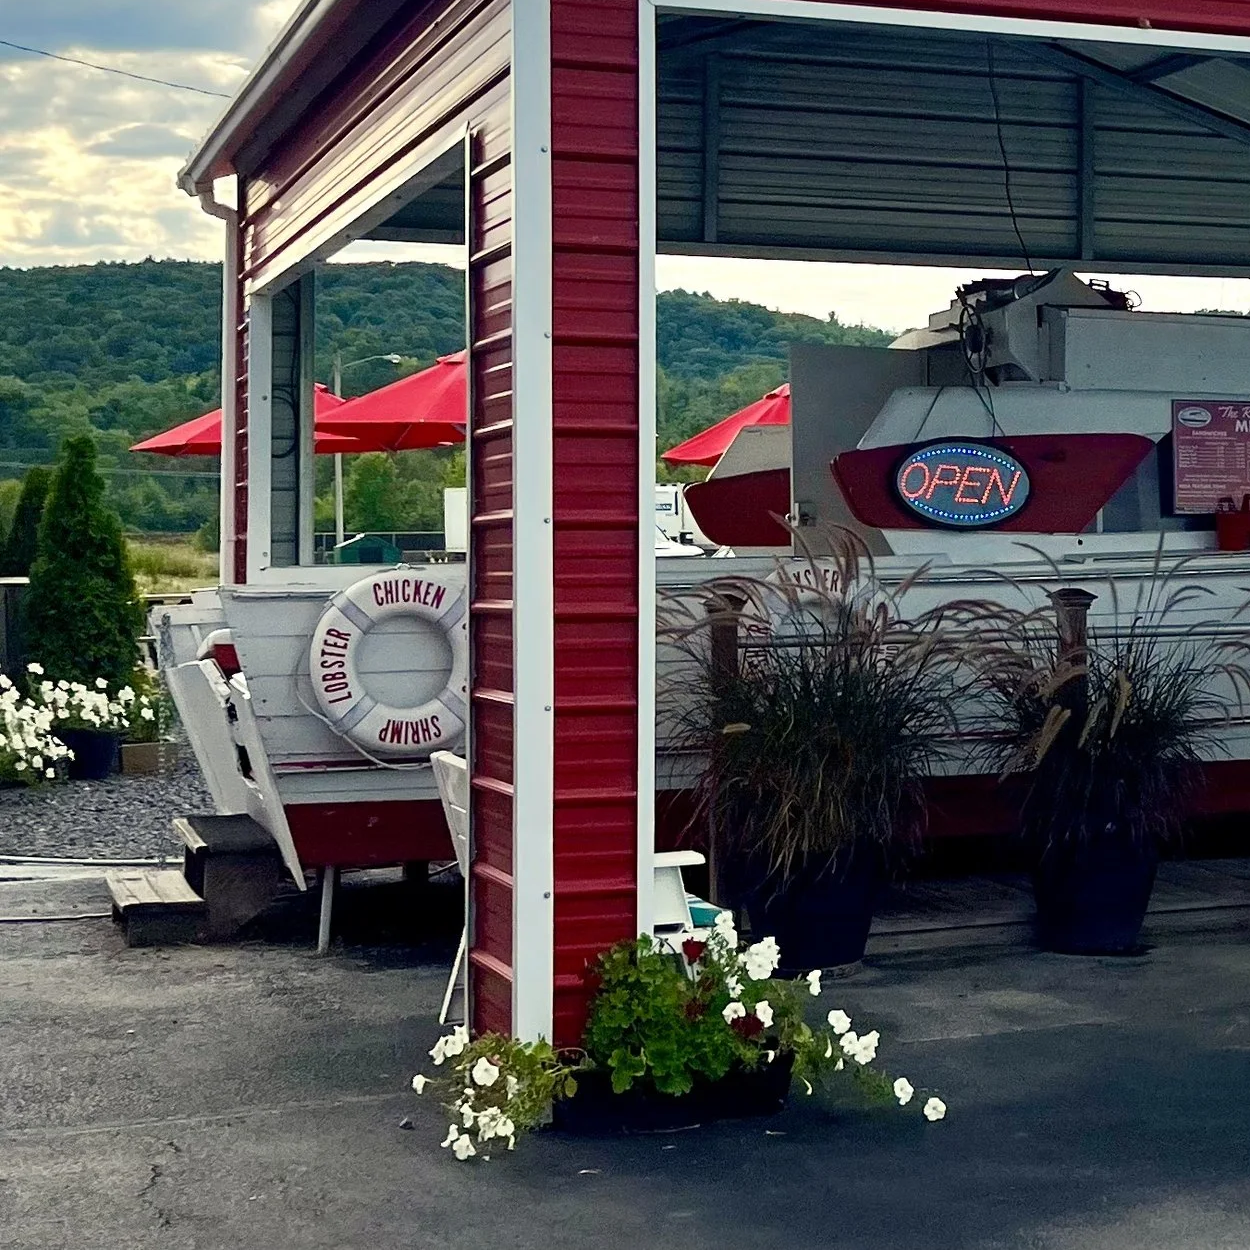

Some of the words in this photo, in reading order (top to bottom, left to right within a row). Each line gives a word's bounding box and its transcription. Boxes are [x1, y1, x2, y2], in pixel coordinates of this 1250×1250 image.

[1218, 405, 1239, 419] The
[900, 461, 1022, 506] OPEN
[372, 579, 447, 609] CHICKEN
[320, 627, 353, 704] LOBSTER
[378, 715, 442, 745] SHRIMP
